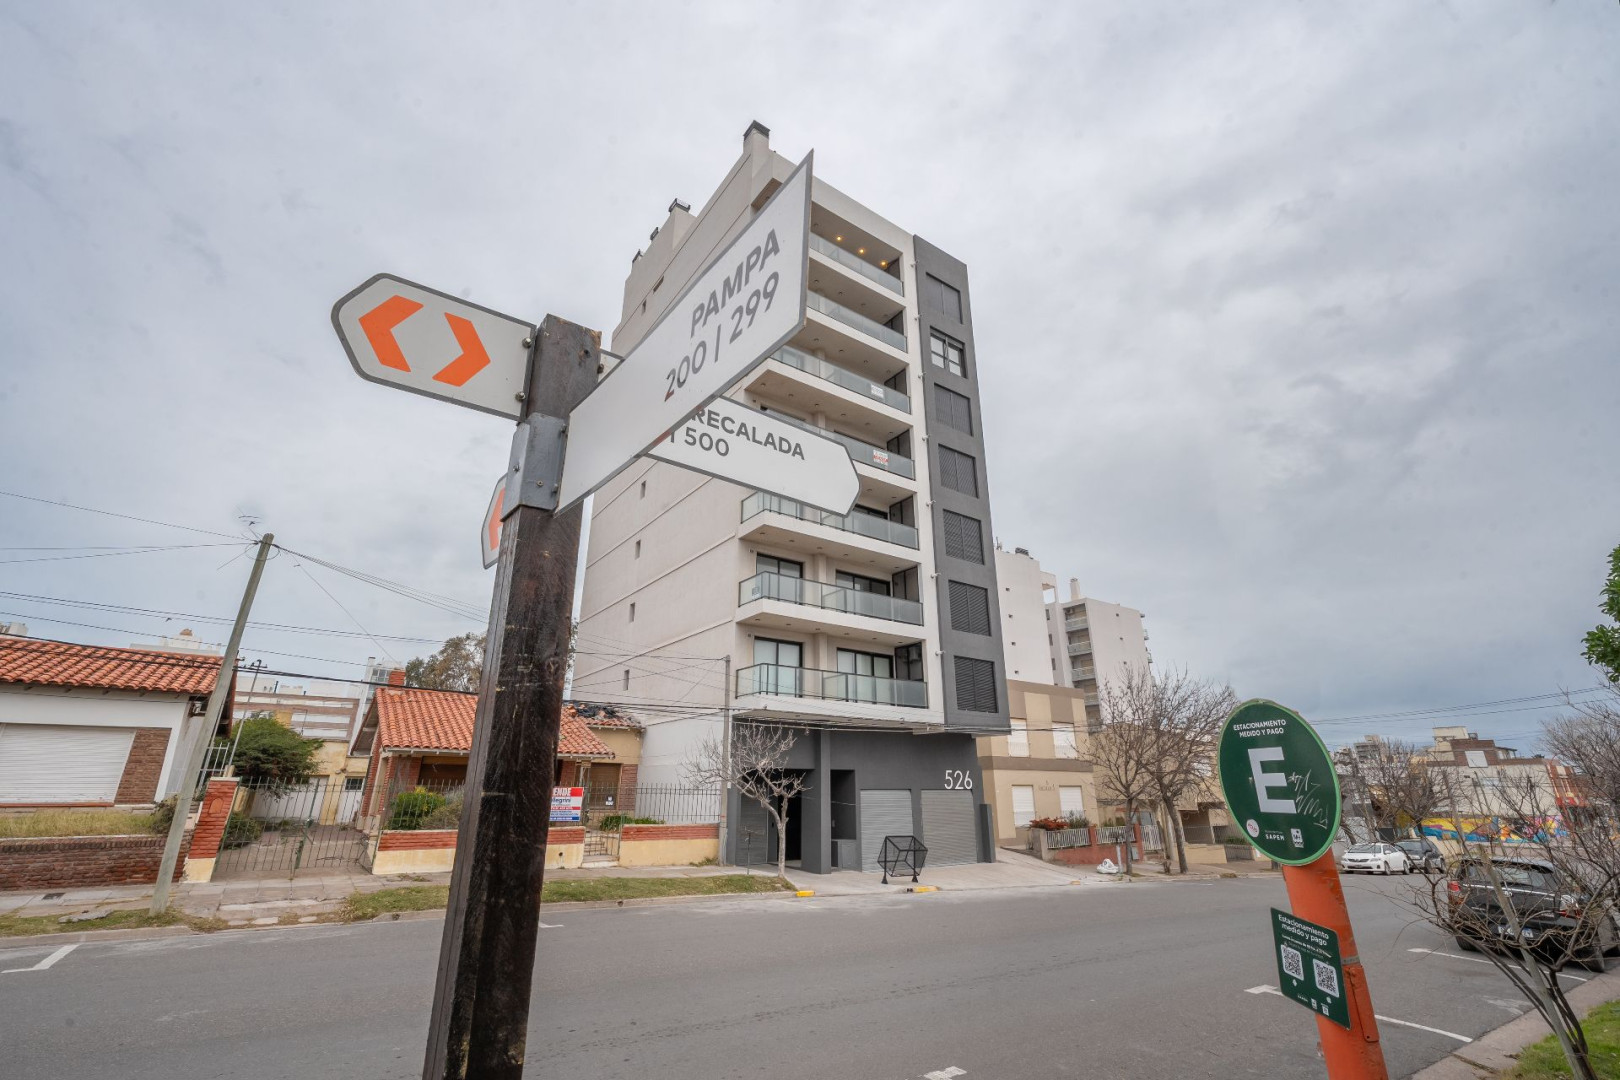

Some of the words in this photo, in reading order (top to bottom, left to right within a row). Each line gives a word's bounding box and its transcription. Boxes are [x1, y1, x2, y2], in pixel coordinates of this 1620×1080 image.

[691, 229, 780, 338] PAMPA
[664, 340, 706, 402] 200
[729, 271, 779, 344] 299
[684, 426, 729, 457] 500
[691, 408, 805, 460] RECALADA
[1233, 719, 1287, 731] ESTACIONAMIENTO
[1239, 730, 1261, 738] MEDIDO
[1266, 727, 1284, 735] PAGO
[944, 769, 973, 790] 526
[1248, 746, 1297, 814] E
[1278, 914, 1330, 940] Estacionamiento
[1281, 923, 1305, 937] medido
[1310, 935, 1328, 946] pago
